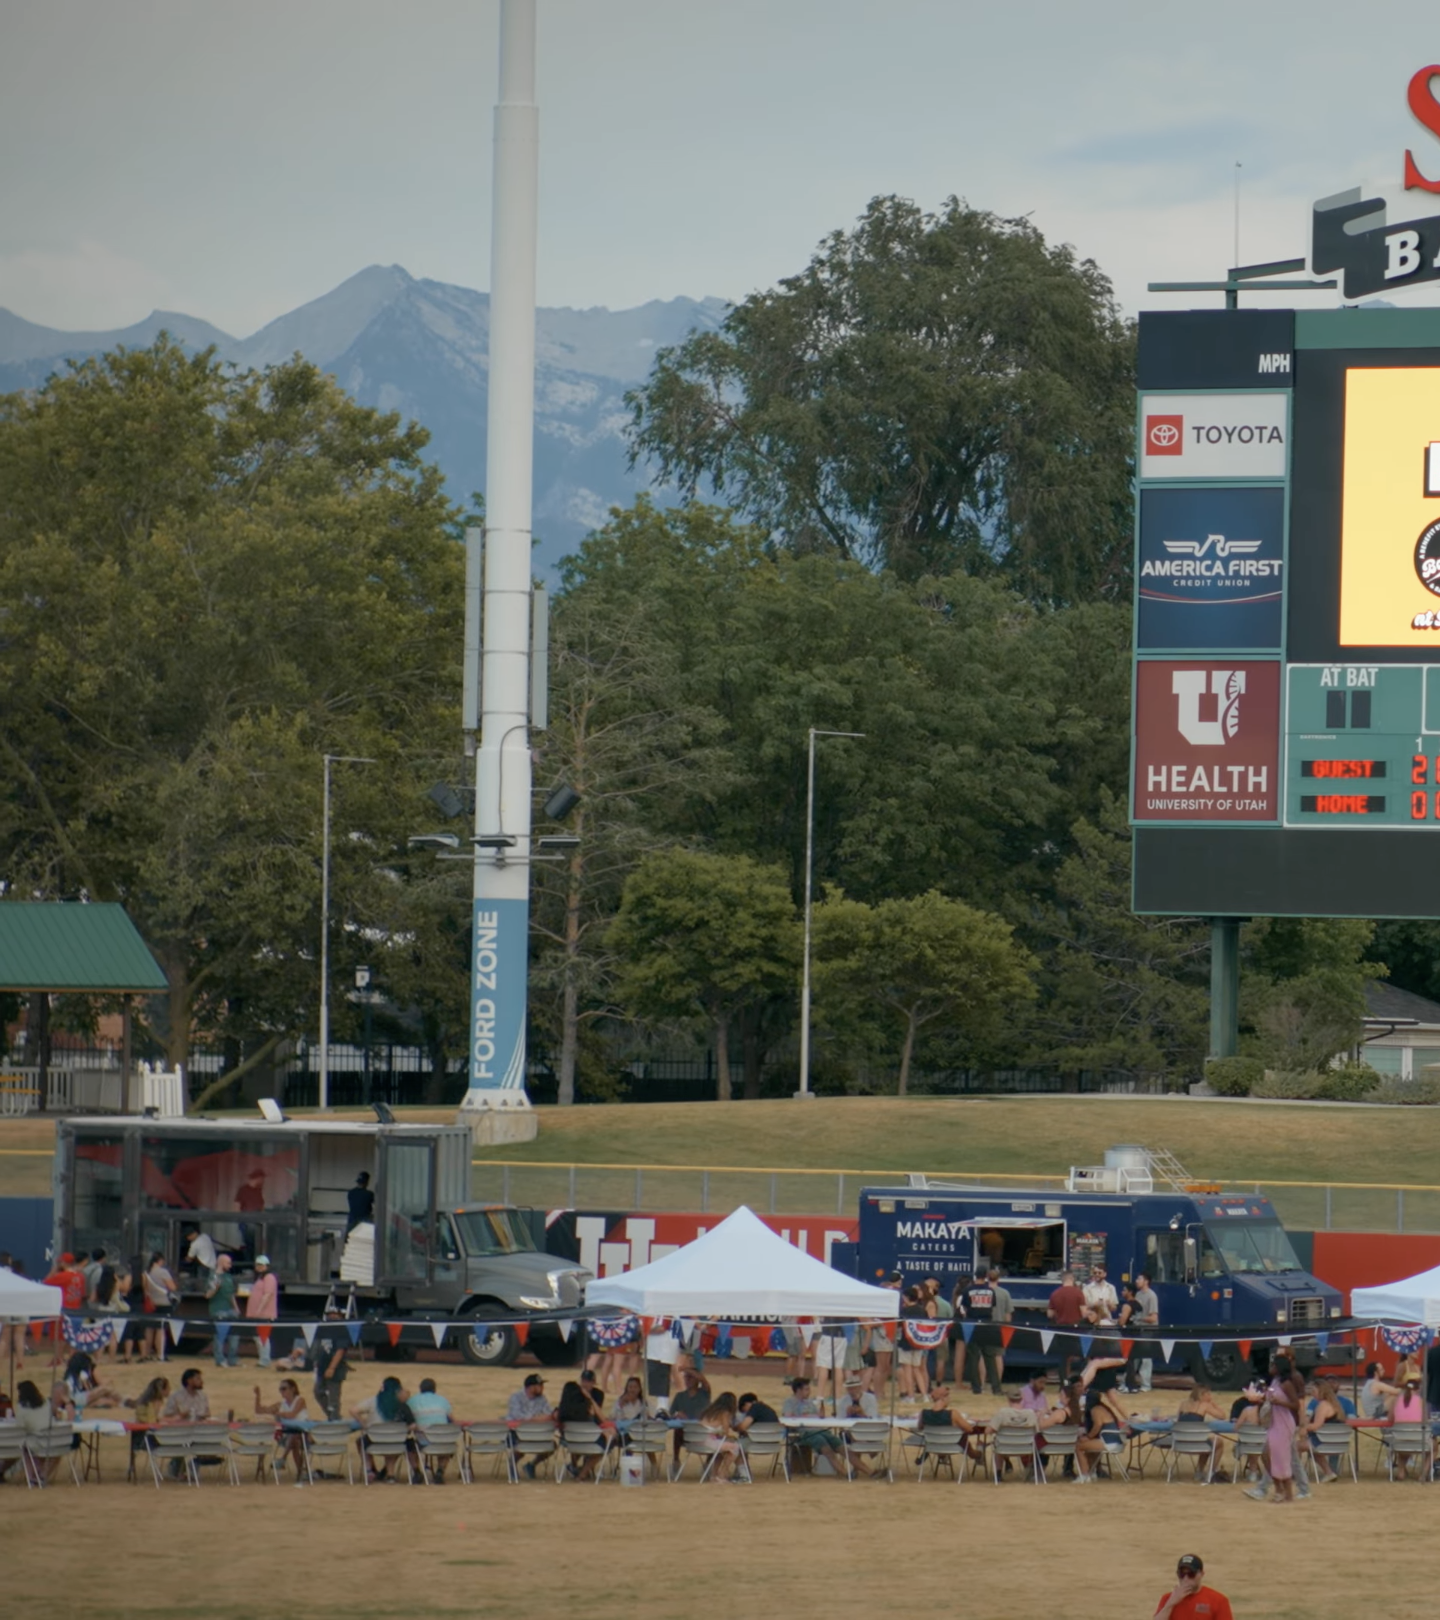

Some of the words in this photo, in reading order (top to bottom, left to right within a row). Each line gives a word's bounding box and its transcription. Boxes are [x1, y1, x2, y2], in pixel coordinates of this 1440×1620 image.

[1258, 353, 1290, 373] MPH
[1192, 425, 1284, 444] TOYOTA
[1141, 560, 1226, 577] AMERICA
[1228, 560, 1283, 577] FIRST
[1173, 579, 1212, 587] CREDIT
[1217, 579, 1251, 587] UNION
[1413, 609, 1434, 629] at
[1320, 668, 1343, 687] AT
[1346, 667, 1378, 687] BAT
[1415, 737, 1423, 753] 1
[1312, 760, 1375, 778] GUEST
[1412, 755, 1428, 785] 2
[1147, 765, 1267, 793] HEALTH
[1147, 799, 1214, 810] UNIVERSITY
[1216, 799, 1233, 810] OF
[1235, 799, 1267, 811] UTAH
[1315, 795, 1369, 814] HOME
[1411, 790, 1427, 819] 0
[476, 911, 498, 990] ZONE
[474, 998, 496, 1079] FORD
[896, 1220, 971, 1240] MAKAYA
[912, 1242, 956, 1252] CATERS
[896, 1260, 902, 1270] A
[905, 1261, 931, 1271] TASTE
[934, 1261, 945, 1272] OF
